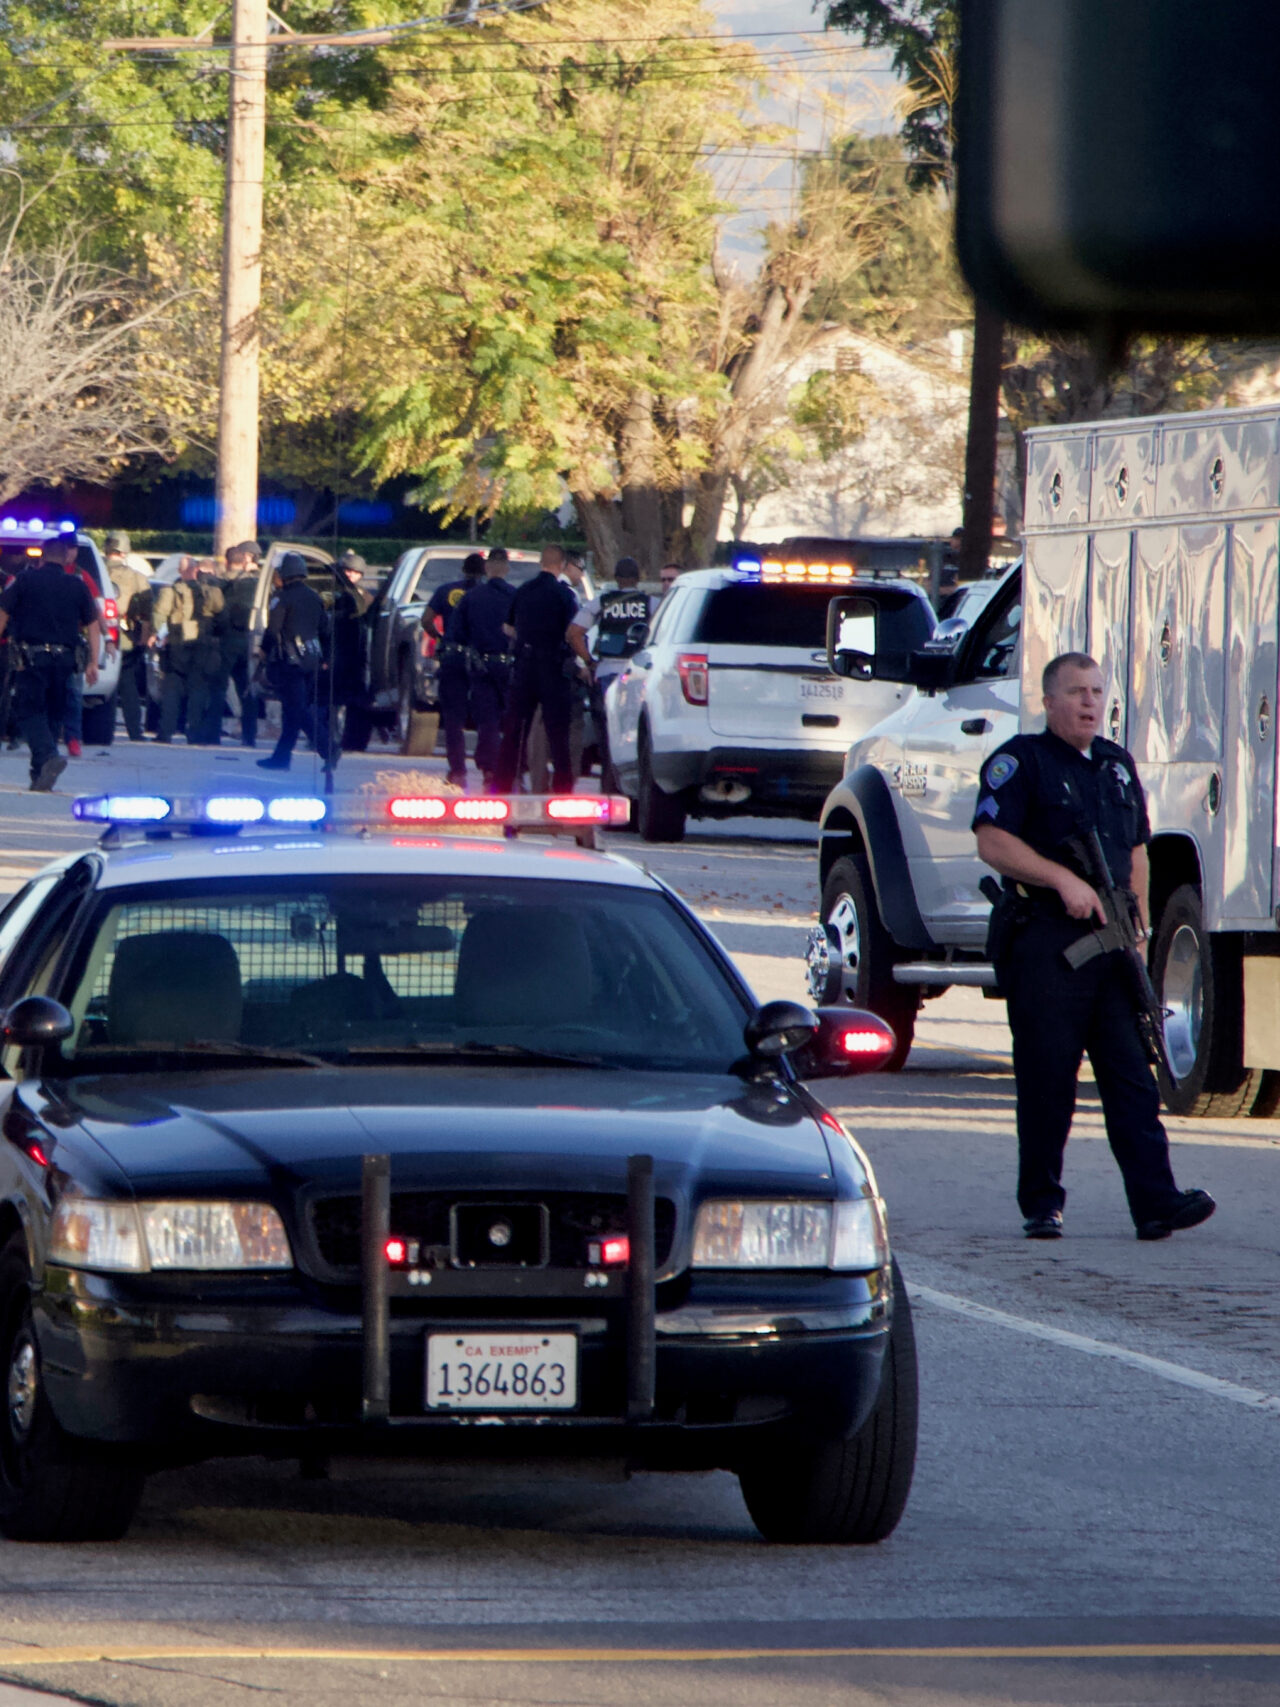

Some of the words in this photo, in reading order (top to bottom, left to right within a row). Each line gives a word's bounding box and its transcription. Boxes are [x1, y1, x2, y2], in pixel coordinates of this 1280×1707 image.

[603, 602, 646, 619] POLICE
[465, 1346, 483, 1357] CA
[490, 1346, 541, 1357] EXEMPT
[438, 1362, 566, 1396] 1364863
